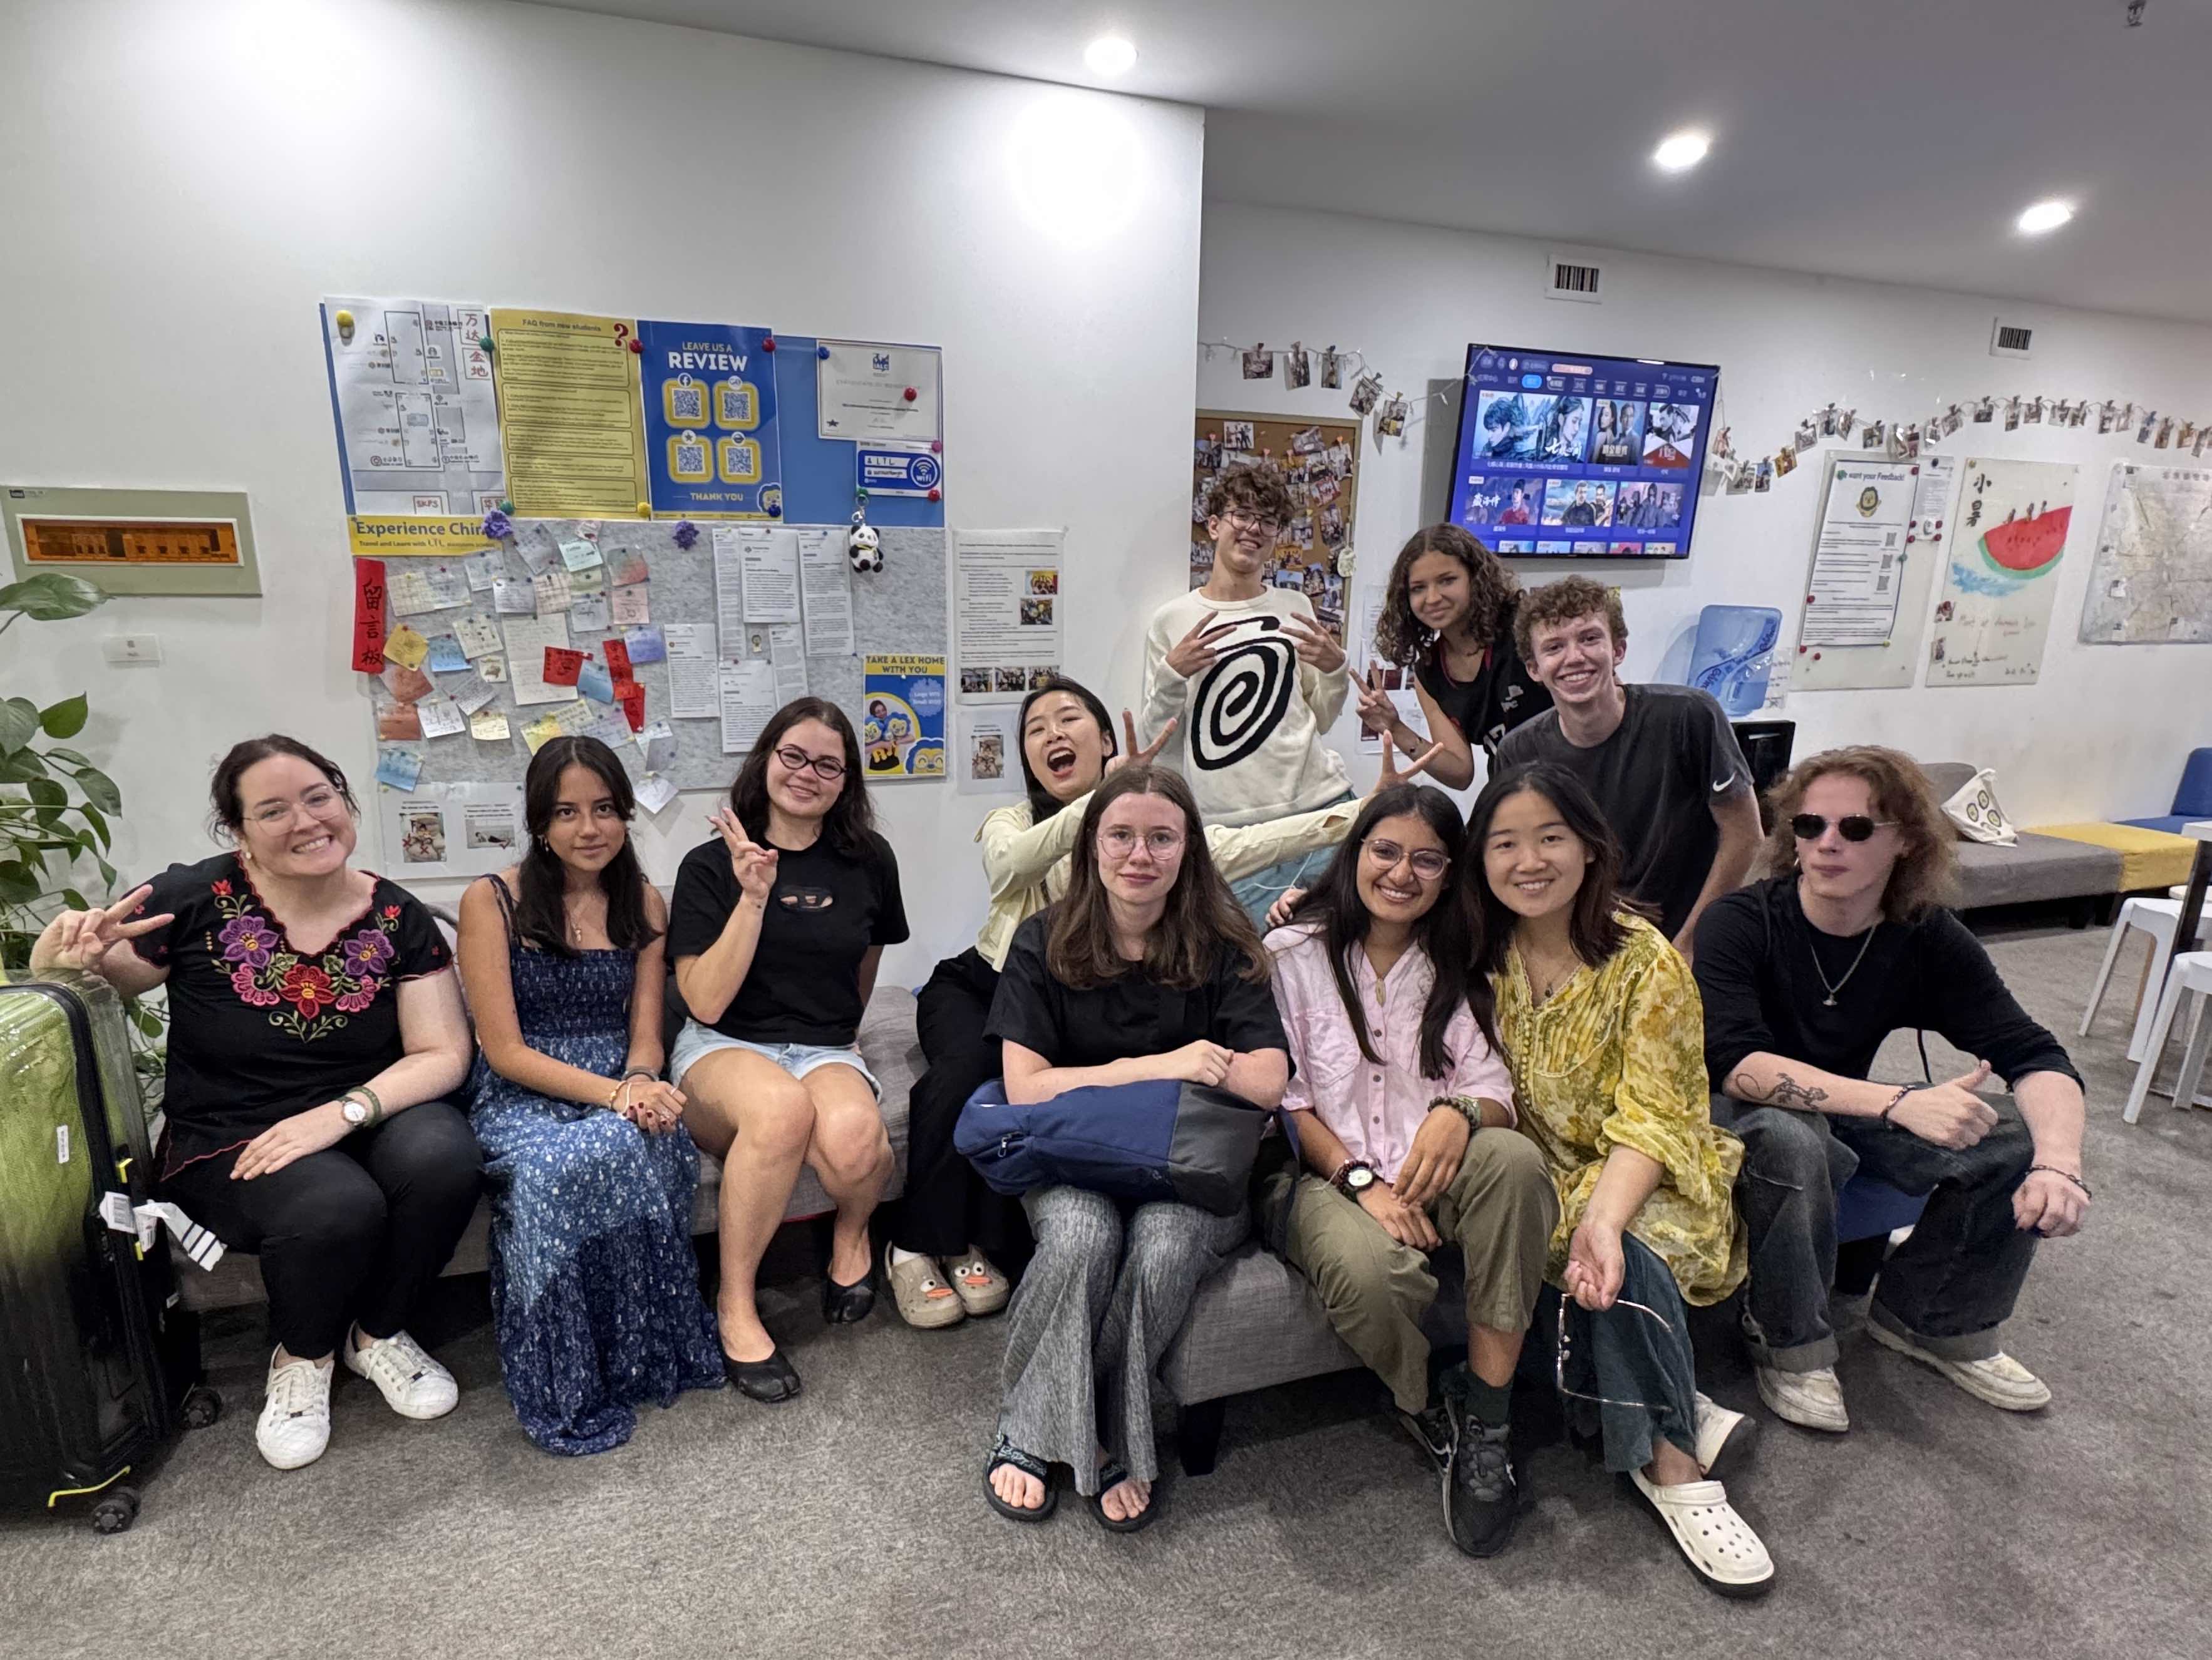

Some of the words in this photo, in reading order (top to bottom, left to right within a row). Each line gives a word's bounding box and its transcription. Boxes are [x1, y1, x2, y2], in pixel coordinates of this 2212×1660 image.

[572, 324, 601, 332] students
[682, 342, 710, 351] LEAVE
[668, 351, 748, 372] REVIEW
[916, 474, 932, 482] wifi
[690, 492, 722, 502] THANK
[725, 493, 744, 502] YOU
[357, 521, 445, 537] Experience
[450, 522, 487, 535] Chin
[918, 656, 945, 664] HOME
